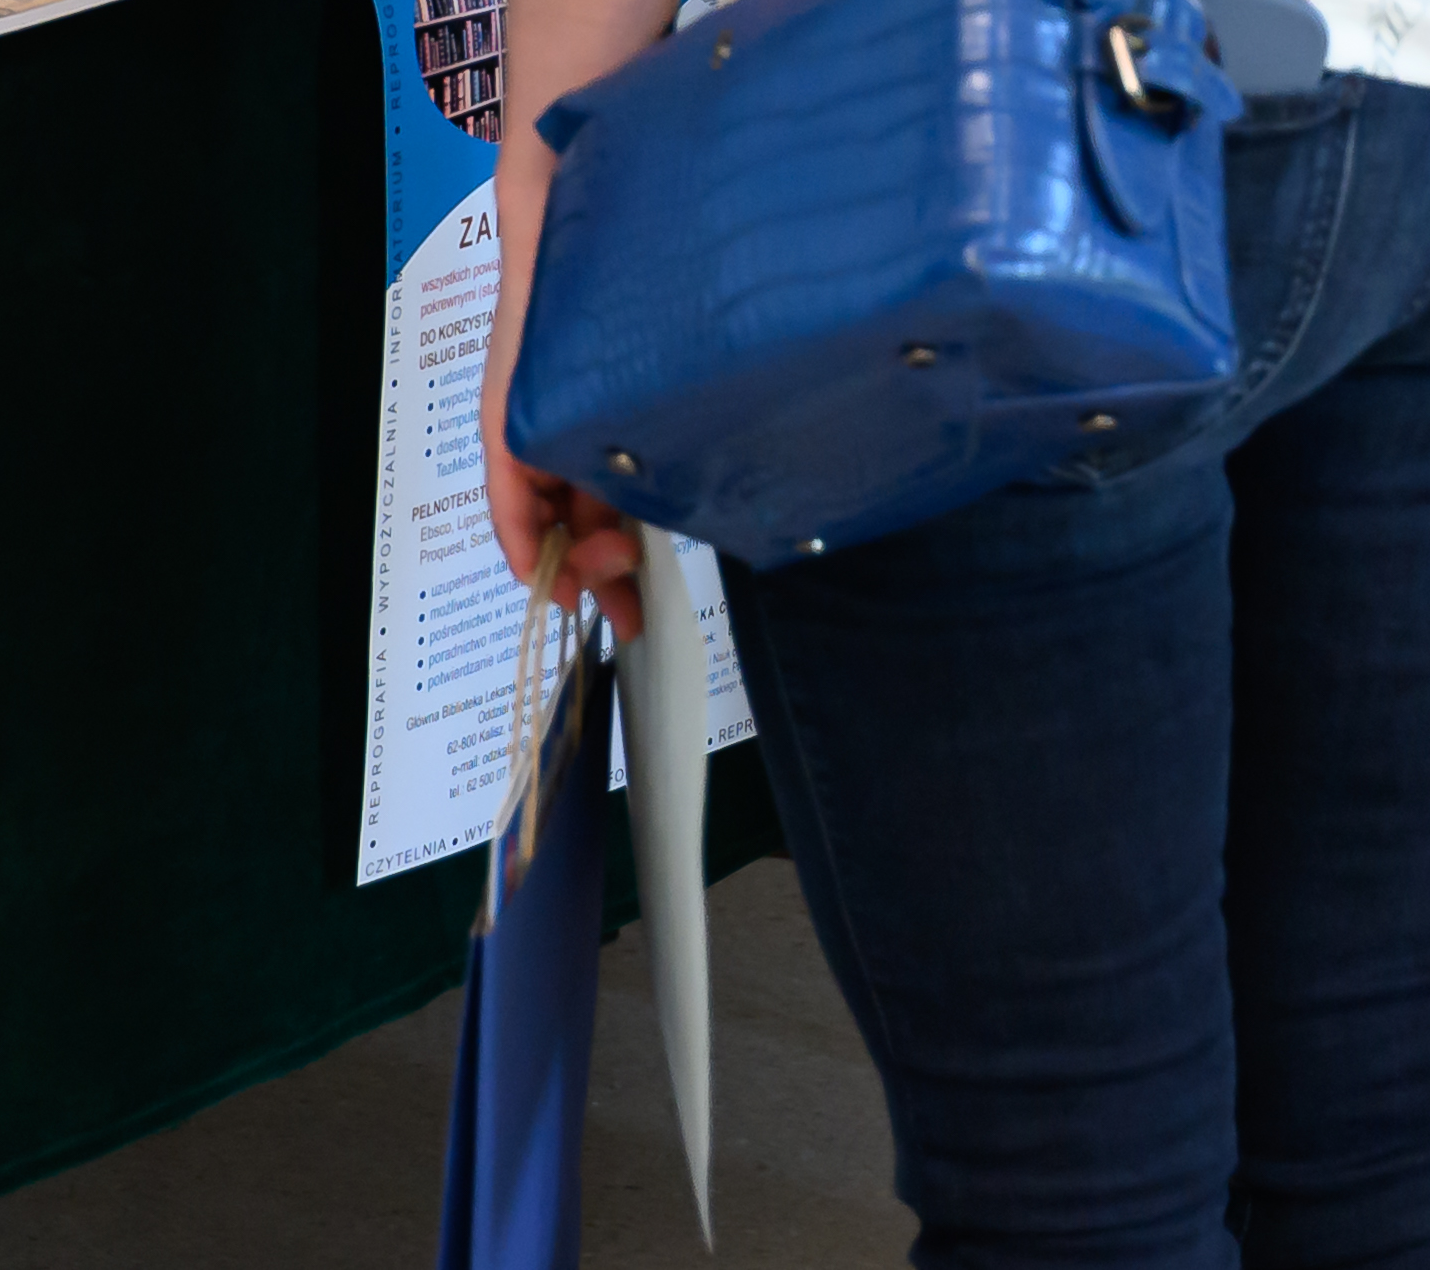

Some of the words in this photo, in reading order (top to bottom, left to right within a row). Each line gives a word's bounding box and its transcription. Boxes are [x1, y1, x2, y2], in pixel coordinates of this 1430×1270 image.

[421, 263, 471, 294] wszystkich
[420, 288, 477, 320] pokrewnymi
[420, 328, 437, 347] DO
[419, 345, 457, 370] USŁUG
[436, 435, 470, 456] dostęp
[436, 449, 484, 478] TezMeSH
[368, 648, 388, 826] REPROGRAFIA
[378, 401, 398, 613] WYPOŻYCZALNIA
[389, 150, 404, 364] INFORMATORIUM
[420, 521, 454, 542] Ebsco,
[419, 538, 467, 565] Proquest,
[431, 566, 491, 598] uzupełnianie
[429, 591, 481, 620] możliwość
[429, 610, 493, 647] pośrednictwo
[494, 608, 503, 619] w
[428, 635, 487, 670] poradnictwo
[427, 654, 494, 692] potwierdzanie
[406, 713, 440, 732] Główna
[442, 695, 484, 719] Biblioteka
[485, 680, 518, 704] Lekarsk
[478, 702, 509, 724] Oddział
[446, 733, 477, 755] 62-800
[466, 778, 477, 793] 62
[478, 772, 495, 788] 500
[496, 766, 508, 781] 07
[365, 838, 447, 877] CZYTELNIA
